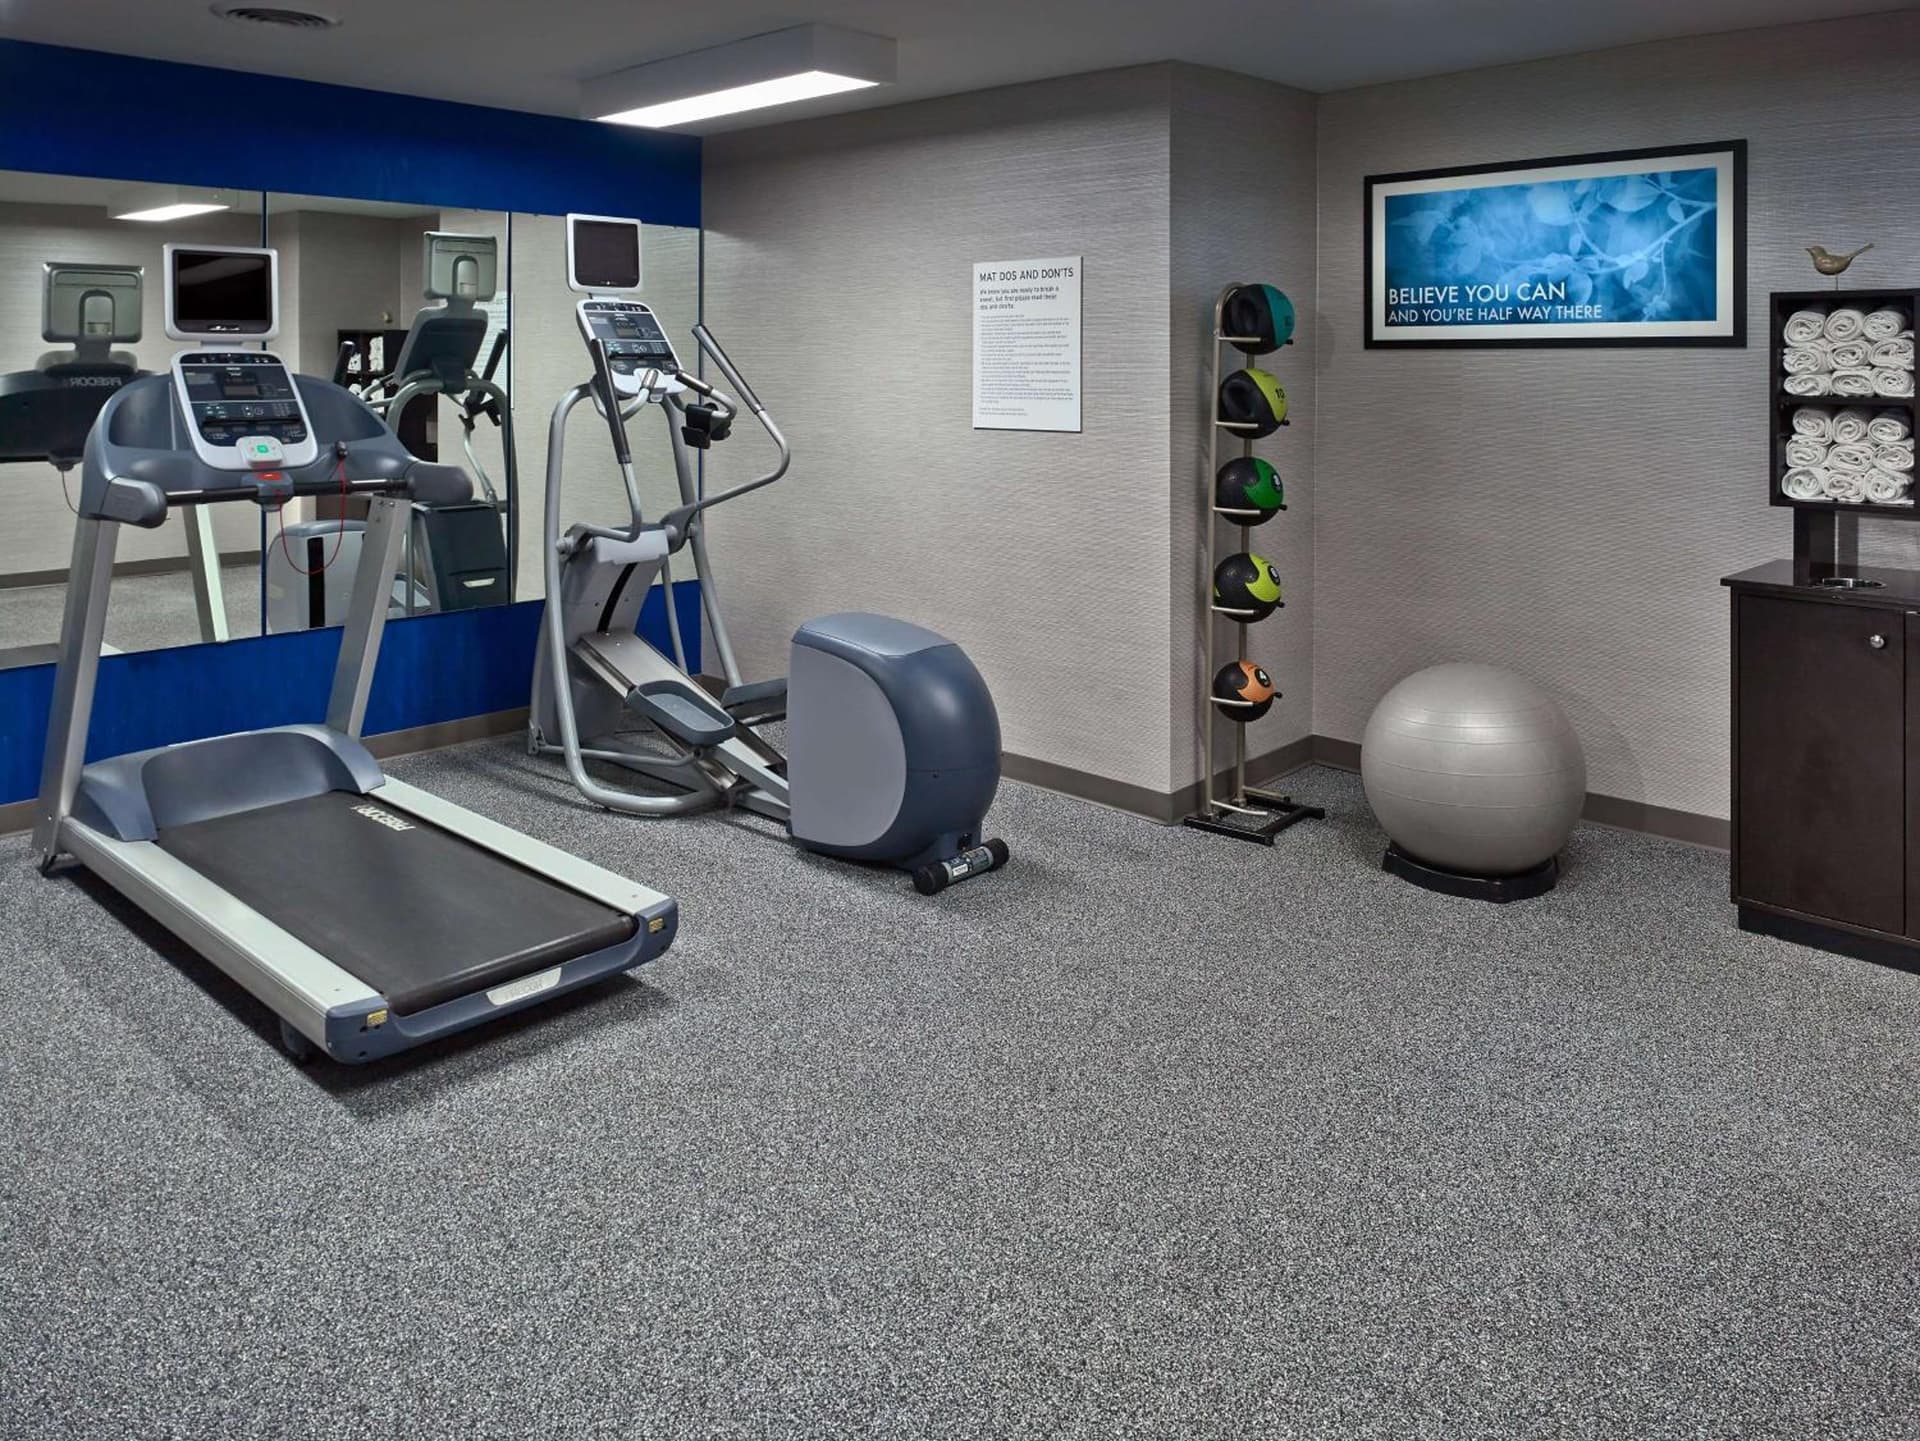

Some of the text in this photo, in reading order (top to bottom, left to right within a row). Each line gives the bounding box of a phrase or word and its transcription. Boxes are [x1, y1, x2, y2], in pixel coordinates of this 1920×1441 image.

[980, 267, 1074, 281] MAT DOS AND DON'TS
[1388, 281, 1566, 305] BELIEVE YOU CAN
[1388, 304, 1603, 323] AND YOU'RE HALF WAY THERE
